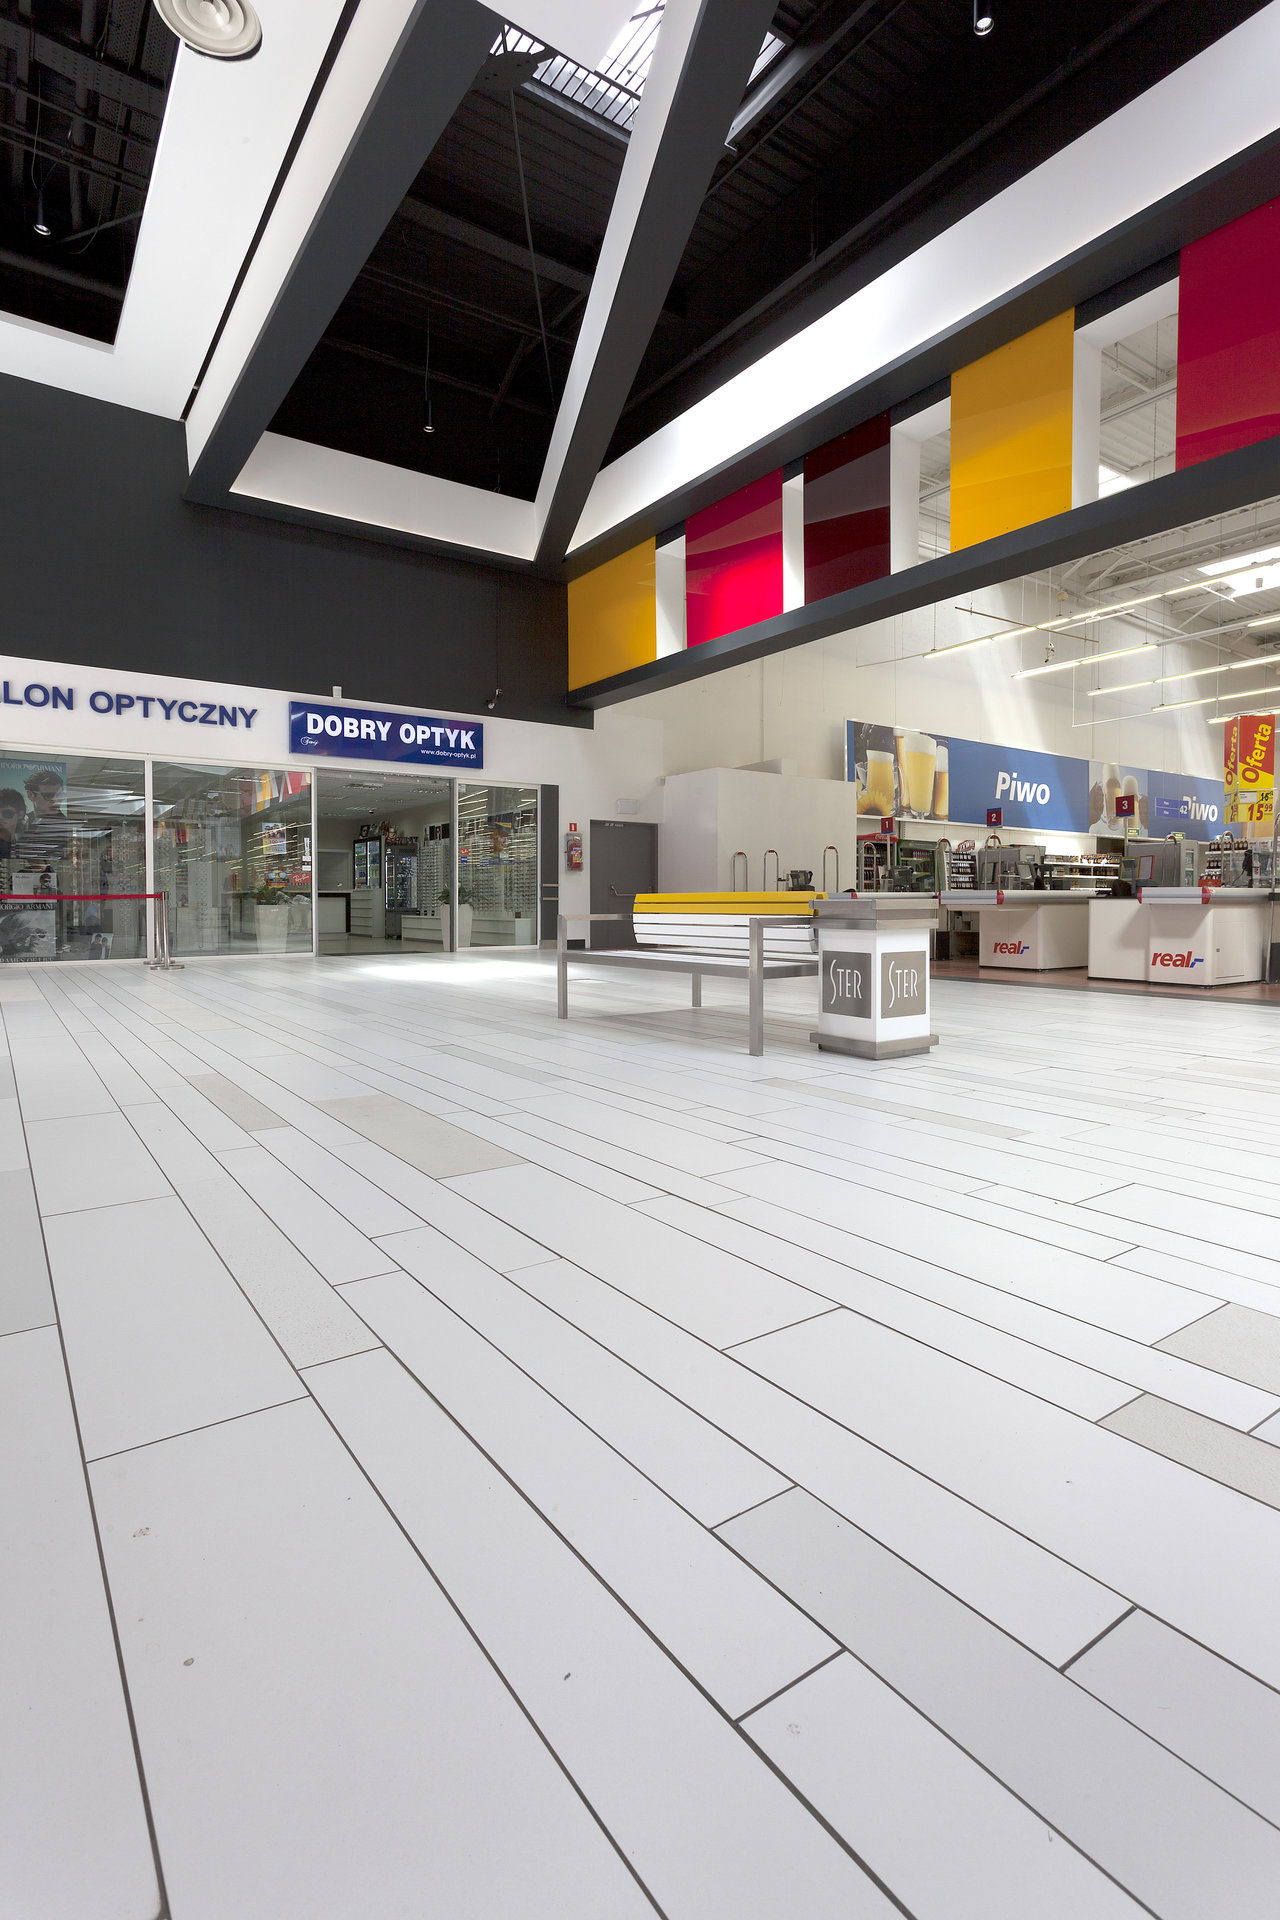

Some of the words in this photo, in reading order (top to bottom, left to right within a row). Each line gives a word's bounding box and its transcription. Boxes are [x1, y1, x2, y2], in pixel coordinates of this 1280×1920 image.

[0, 681, 74, 711] LON
[89, 691, 258, 729] OPTYCZNY
[306, 712, 392, 742] DOBRY
[399, 723, 475, 750] OPTYK
[420, 748, 477, 759] www.dobry-optyk.pl
[1225, 726, 1238, 786] Oferta
[1241, 723, 1272, 784] Oferta
[995, 771, 1051, 805] Piwo
[1121, 800, 1128, 810] 3
[1179, 805, 1188, 815] 42
[885, 820, 889, 829] 1
[991, 813, 997, 822] 2
